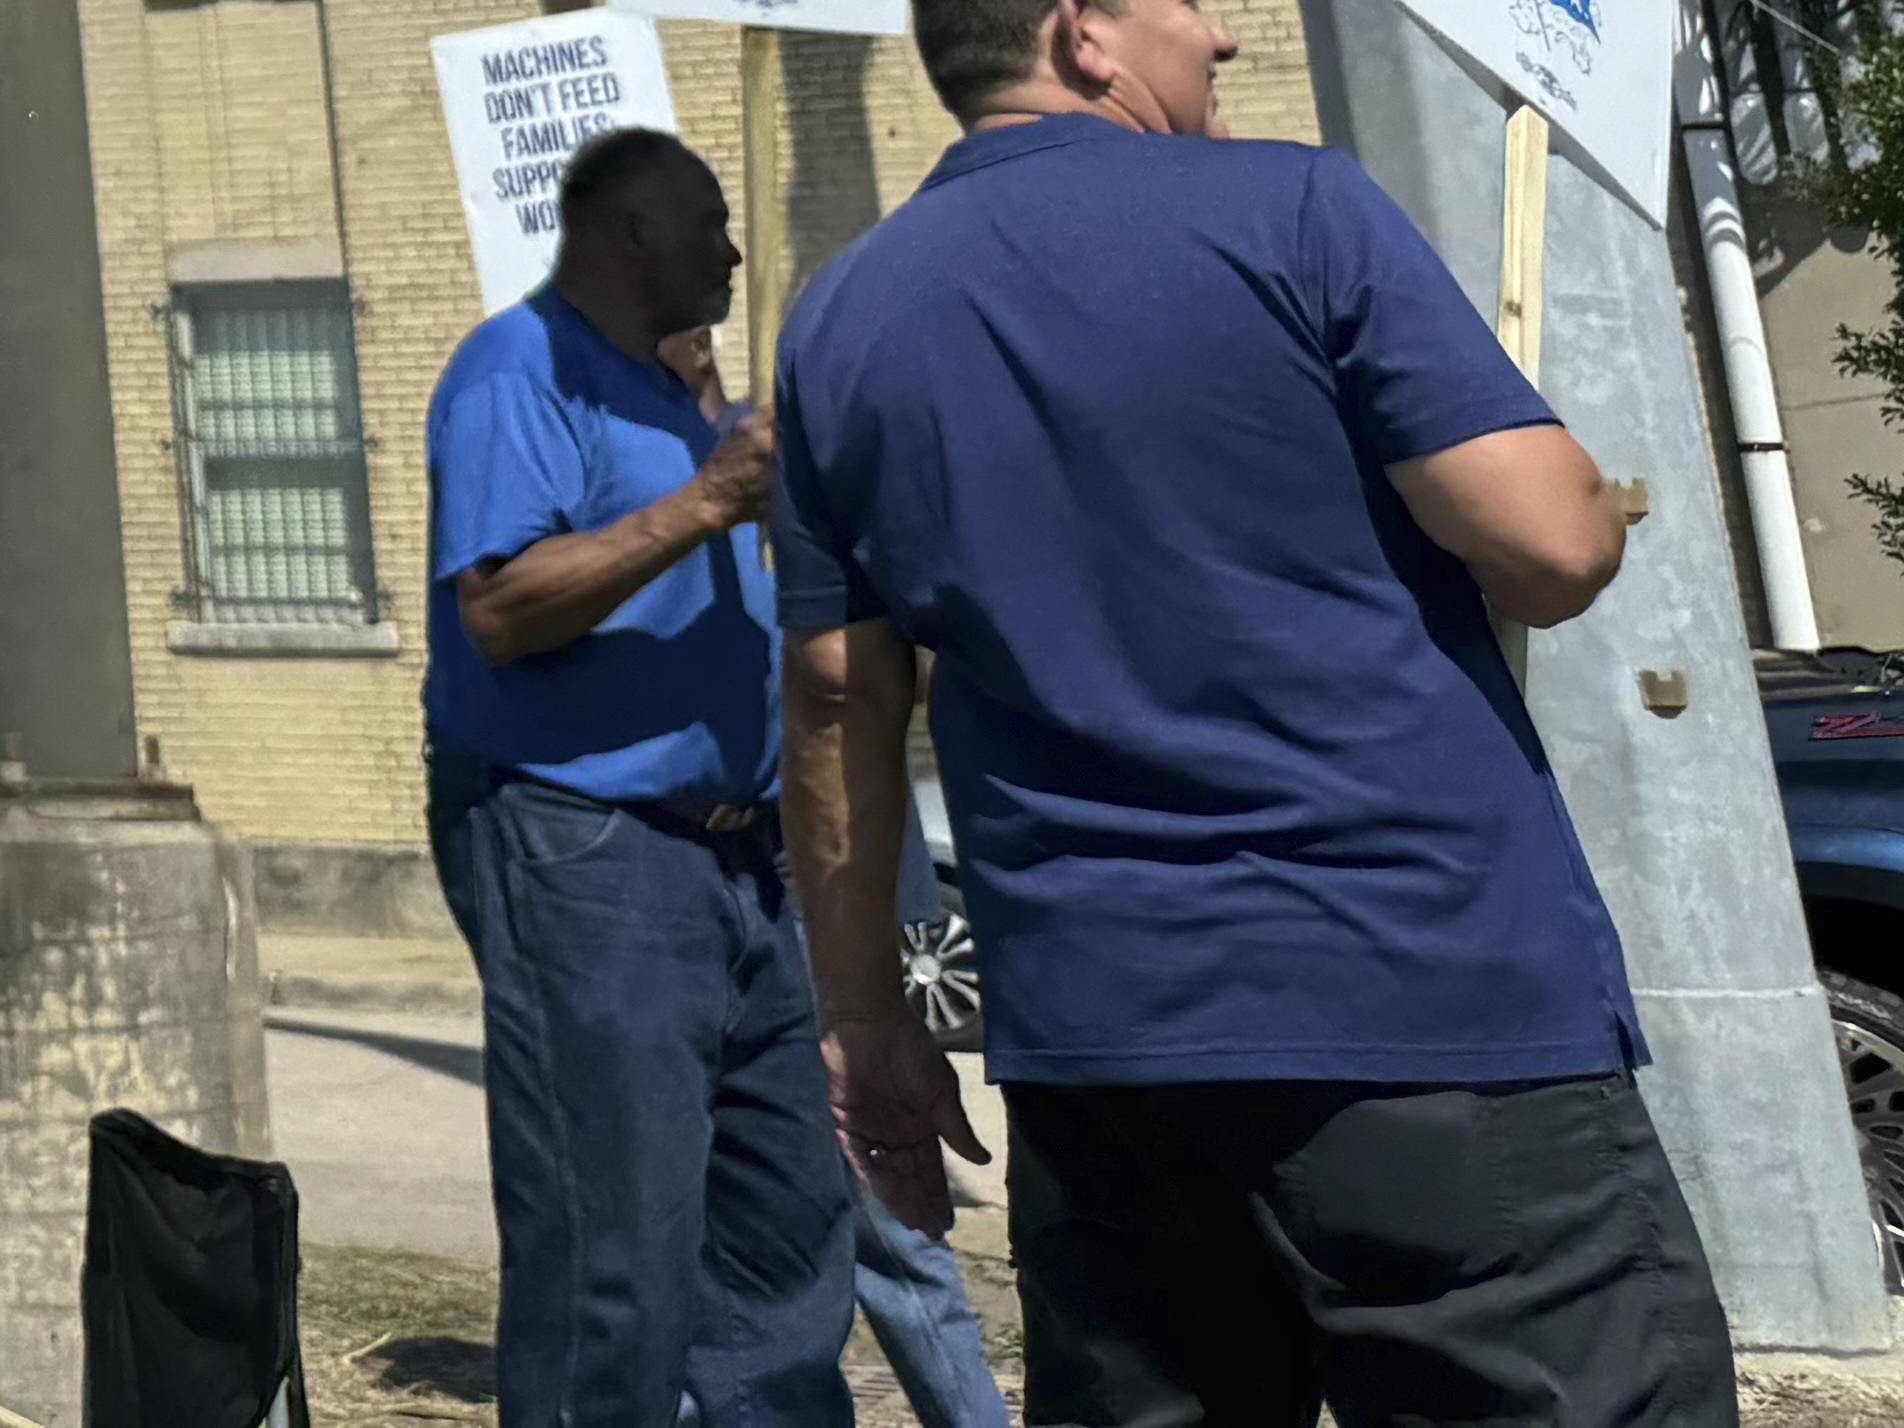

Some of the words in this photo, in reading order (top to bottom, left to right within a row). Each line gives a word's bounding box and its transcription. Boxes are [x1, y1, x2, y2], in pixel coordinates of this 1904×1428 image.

[482, 35, 607, 85] MACHINES
[484, 85, 554, 123] DON'T
[560, 72, 620, 111] FEED
